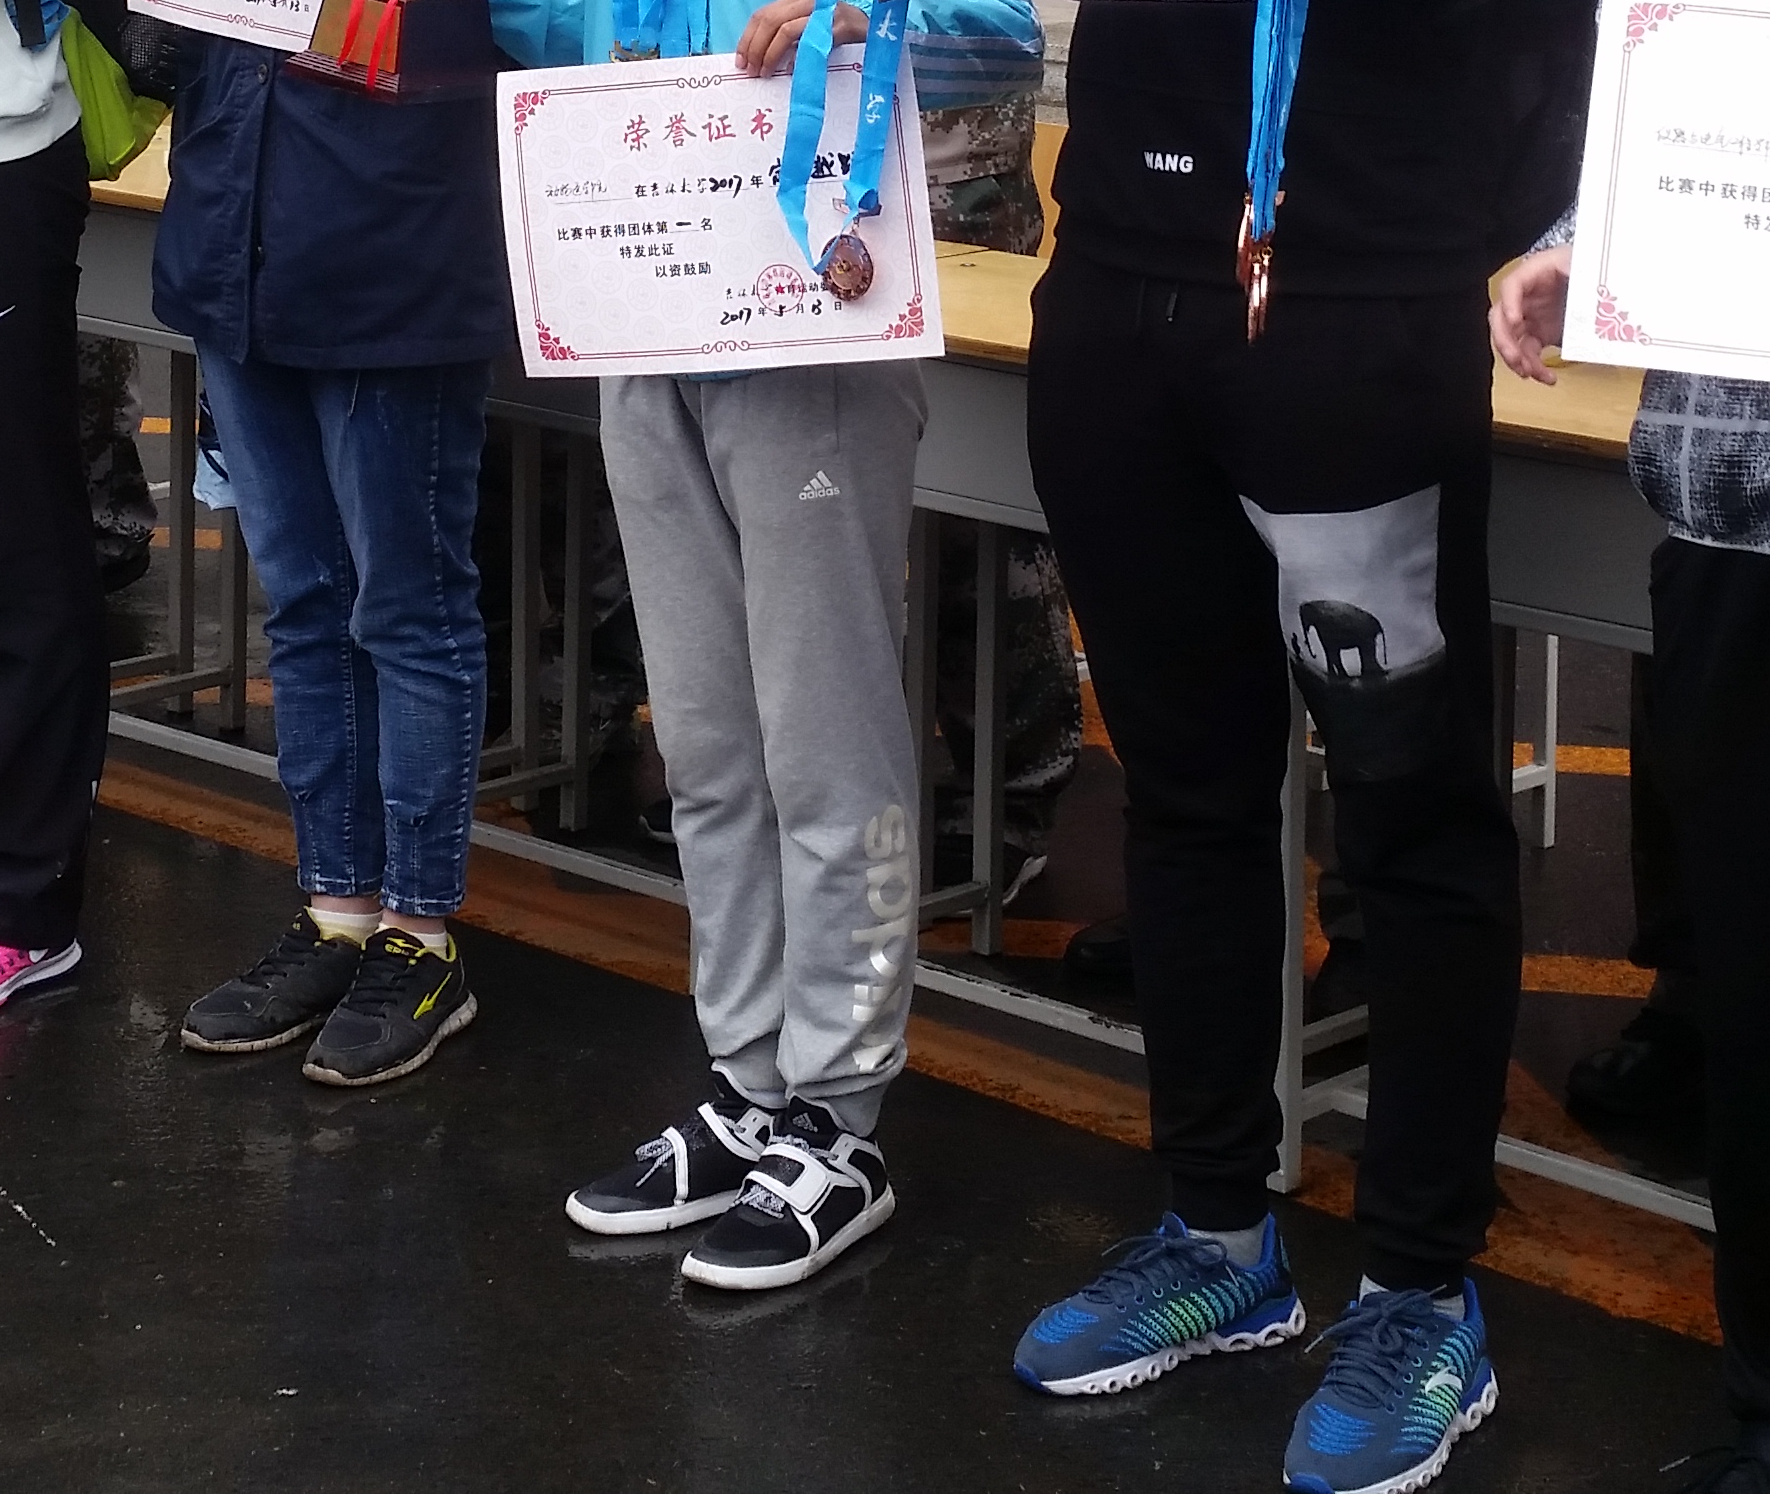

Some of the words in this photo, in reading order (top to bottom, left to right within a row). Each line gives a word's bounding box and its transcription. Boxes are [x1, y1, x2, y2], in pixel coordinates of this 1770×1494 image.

[623, 107, 775, 153] 荣誉证书
[1144, 151, 1194, 174] WANG
[557, 217, 714, 242] 比赛中获得团体第一名
[619, 242, 676, 259] 特发此证
[655, 261, 712, 279] 以资鼓励
[798, 485, 840, 501] adidas
